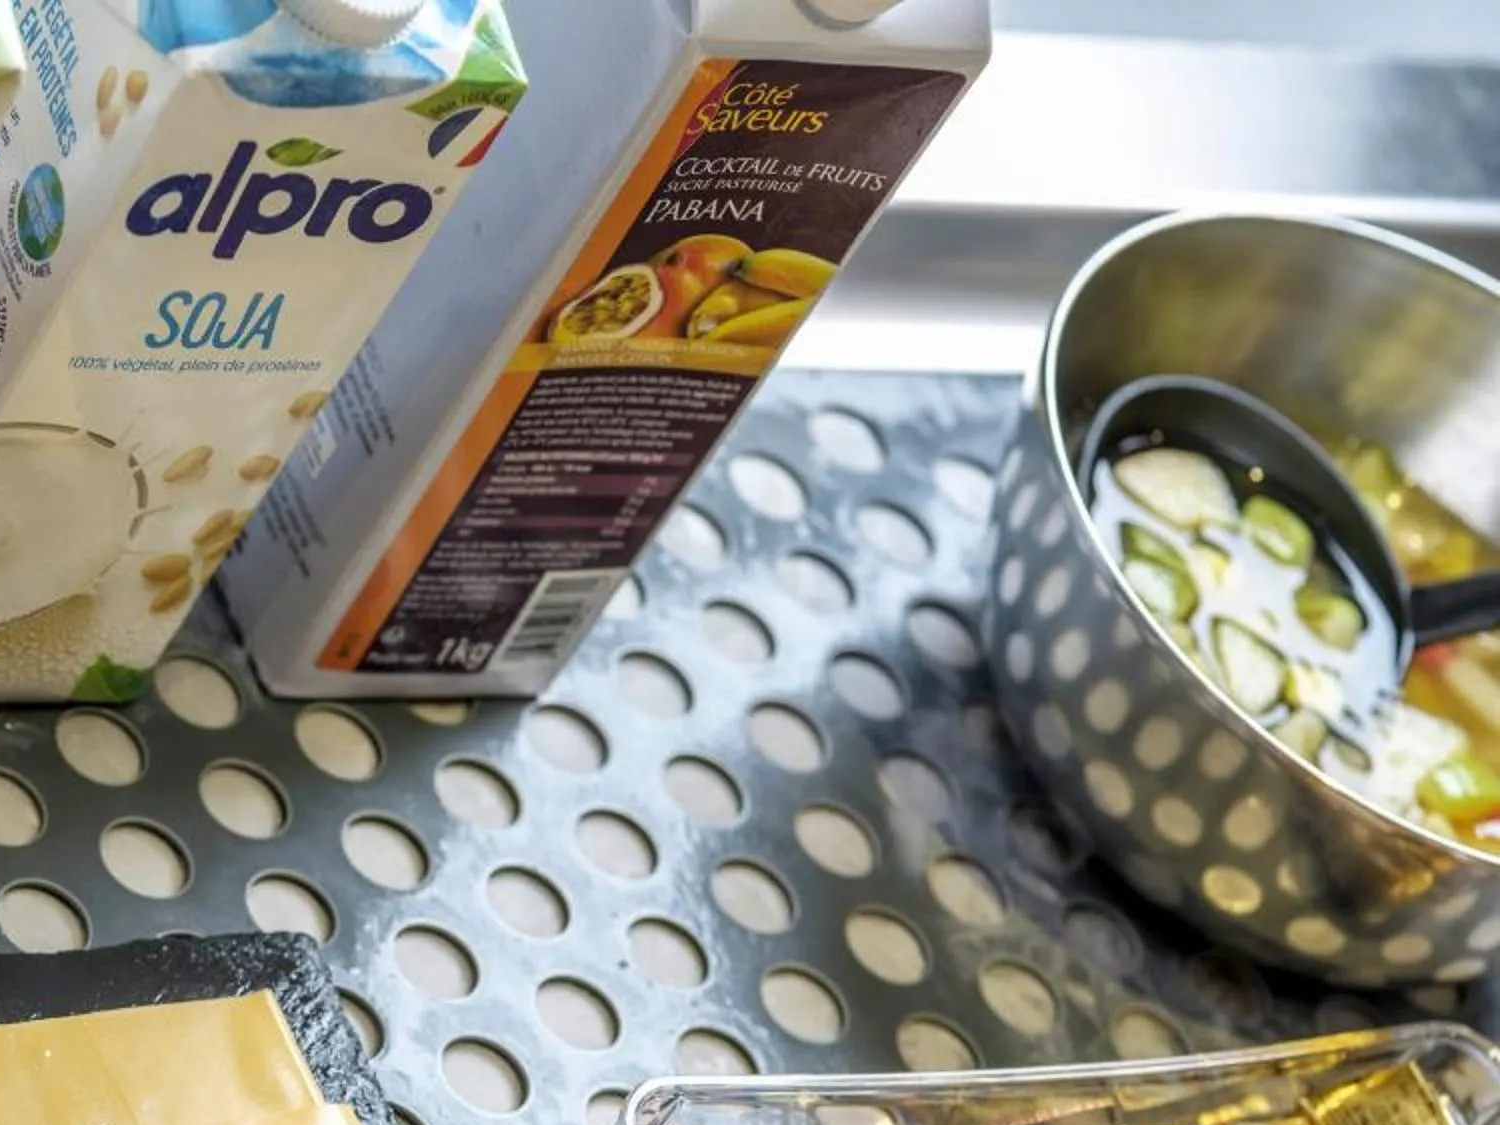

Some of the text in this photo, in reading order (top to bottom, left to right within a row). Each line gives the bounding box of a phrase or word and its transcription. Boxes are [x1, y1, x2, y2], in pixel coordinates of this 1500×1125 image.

[722, 82, 801, 107] Côté
[686, 103, 831, 135] Saveurs
[675, 157, 780, 177] COCKTAIL
[807, 162, 888, 192] FRUITS
[125, 140, 434, 259] alpro
[645, 198, 765, 224] PABANA
[145, 289, 285, 351] SOJA
[68, 355, 108, 371] 100%
[222, 356, 246, 374] de
[436, 637, 496, 671] 1kg
